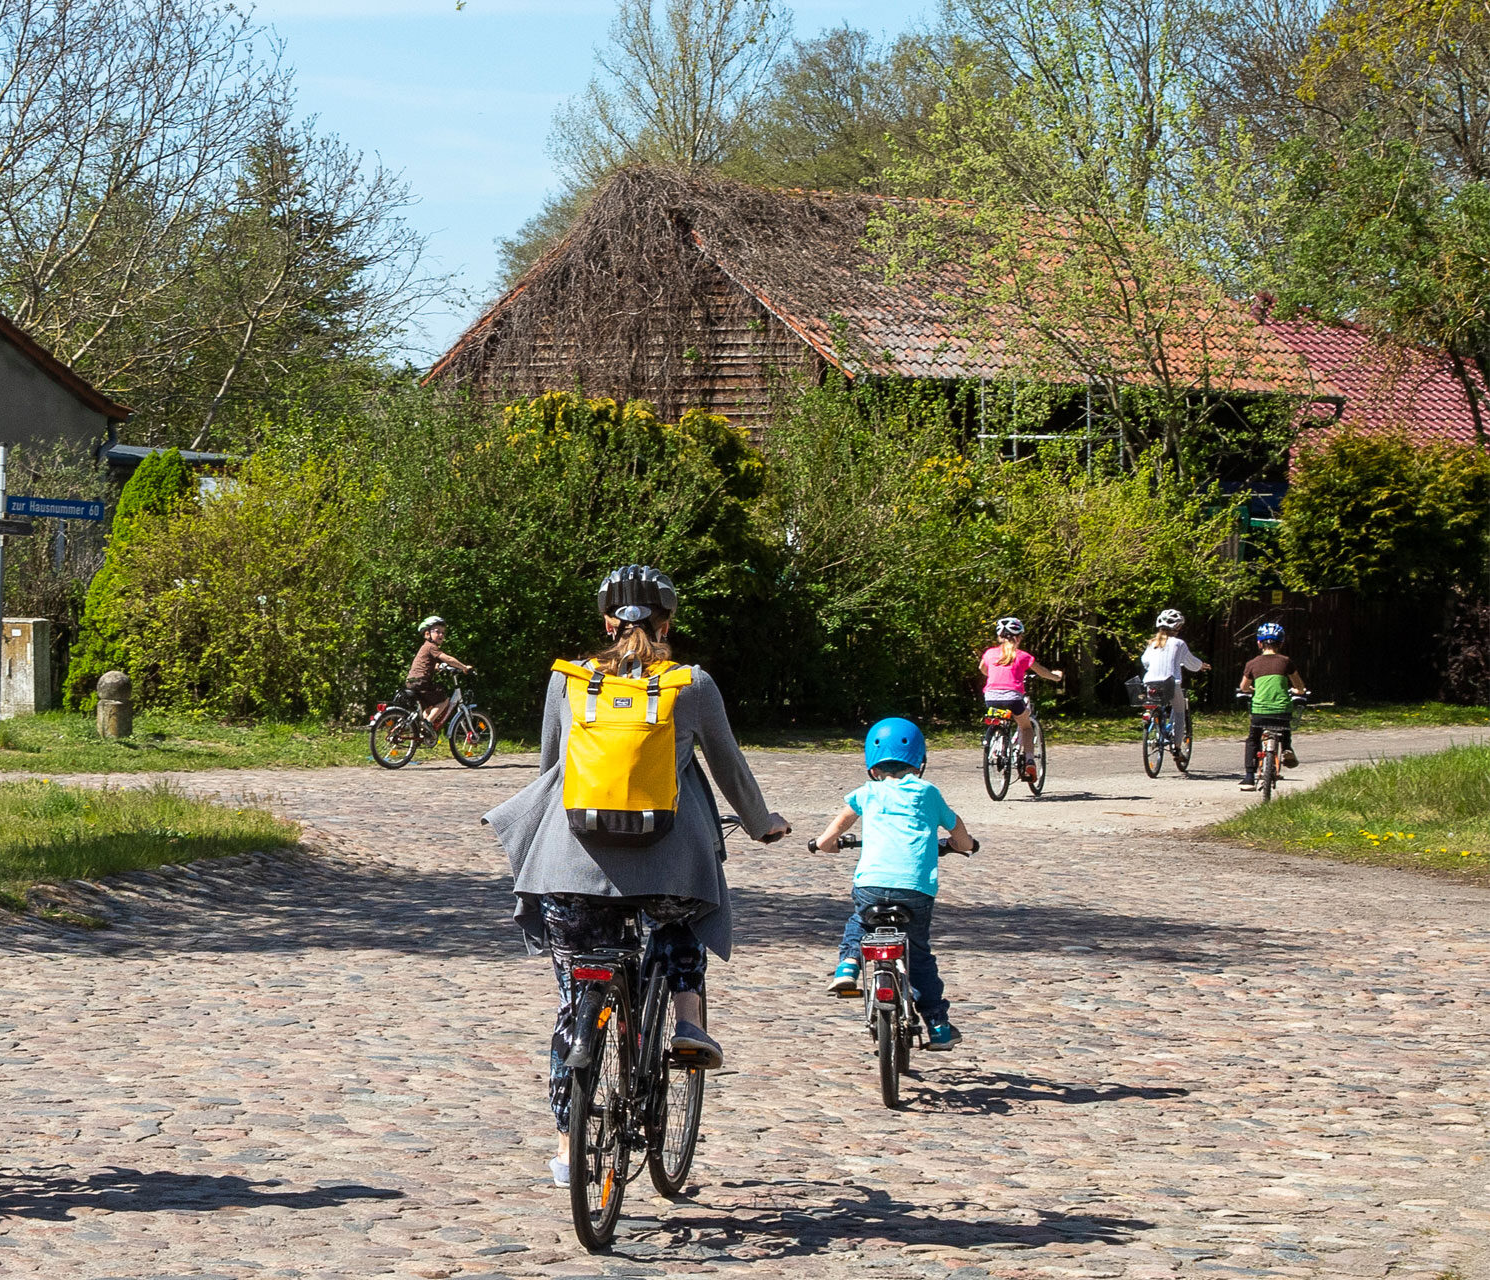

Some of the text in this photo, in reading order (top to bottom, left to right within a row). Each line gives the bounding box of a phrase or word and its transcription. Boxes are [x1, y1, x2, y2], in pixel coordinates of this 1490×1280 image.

[11, 501, 100, 516] zur Hausnummer 60
